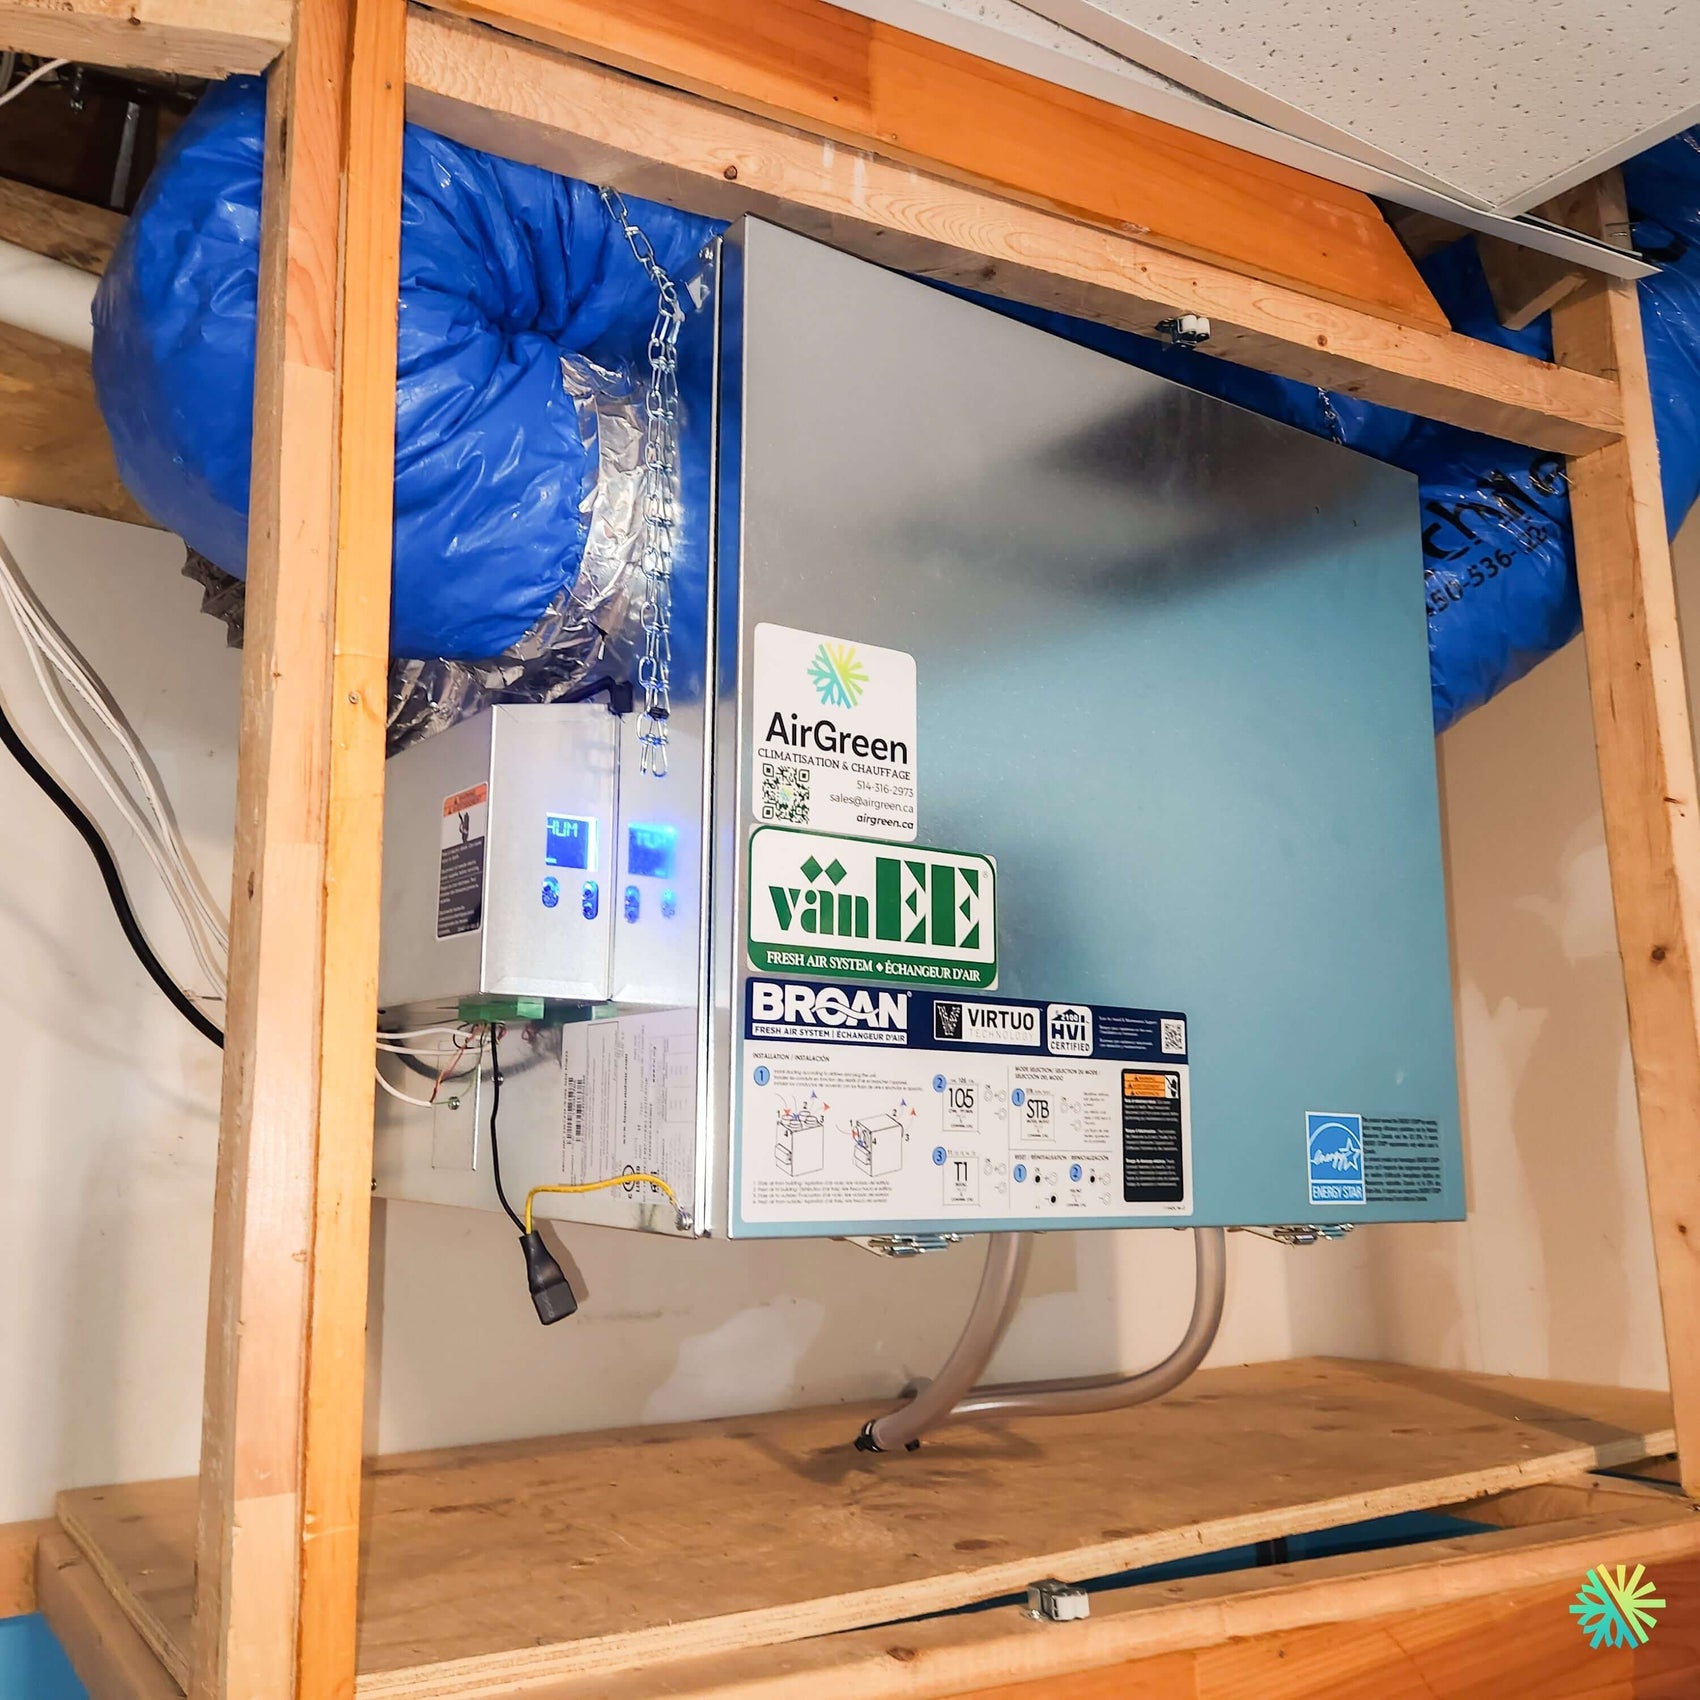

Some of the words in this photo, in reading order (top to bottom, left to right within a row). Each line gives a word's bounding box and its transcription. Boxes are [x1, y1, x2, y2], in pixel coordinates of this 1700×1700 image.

[765, 711, 908, 765] AirGreen
[757, 747, 840, 769] CLIMATISATION
[842, 761, 849, 771] &
[851, 762, 911, 781] CHAUFFAGE
[856, 779, 914, 798] 514-316-2973
[829, 793, 914, 814] sales@airgreen.ca
[856, 813, 914, 830] airgreen.ca
[768, 855, 980, 950] vänEE
[766, 950, 805, 966] FRESH
[806, 954, 828, 968] AIR
[829, 956, 873, 972] SYSTEM
[885, 959, 952, 978] ÉCHANGEUR
[953, 968, 981, 982] D'AIR
[752, 981, 908, 1030] BROAN
[967, 1008, 1034, 1031] VIRTUO
[755, 1025, 782, 1035] FRESH
[784, 1027, 798, 1036] AIR
[799, 1028, 830, 1038] SYSTEM
[885, 1033, 906, 1042] D'AIR
[969, 1029, 1034, 1041] TECHNOLOGY
[1051, 1021, 1086, 1041] HVI
[1050, 1041, 1091, 1052] CERTIFIED
[937, 1077, 943, 1089] 2
[802, 1101, 808, 1109] 2
[948, 1087, 974, 1109] 105
[1026, 1099, 1050, 1119] STB
[936, 1150, 943, 1162] 3
[953, 1161, 968, 1182] T1
[1072, 1166, 1079, 1178] 2
[1311, 1184, 1342, 1200] ENERGY
[1342, 1185, 1363, 1200] STAR
